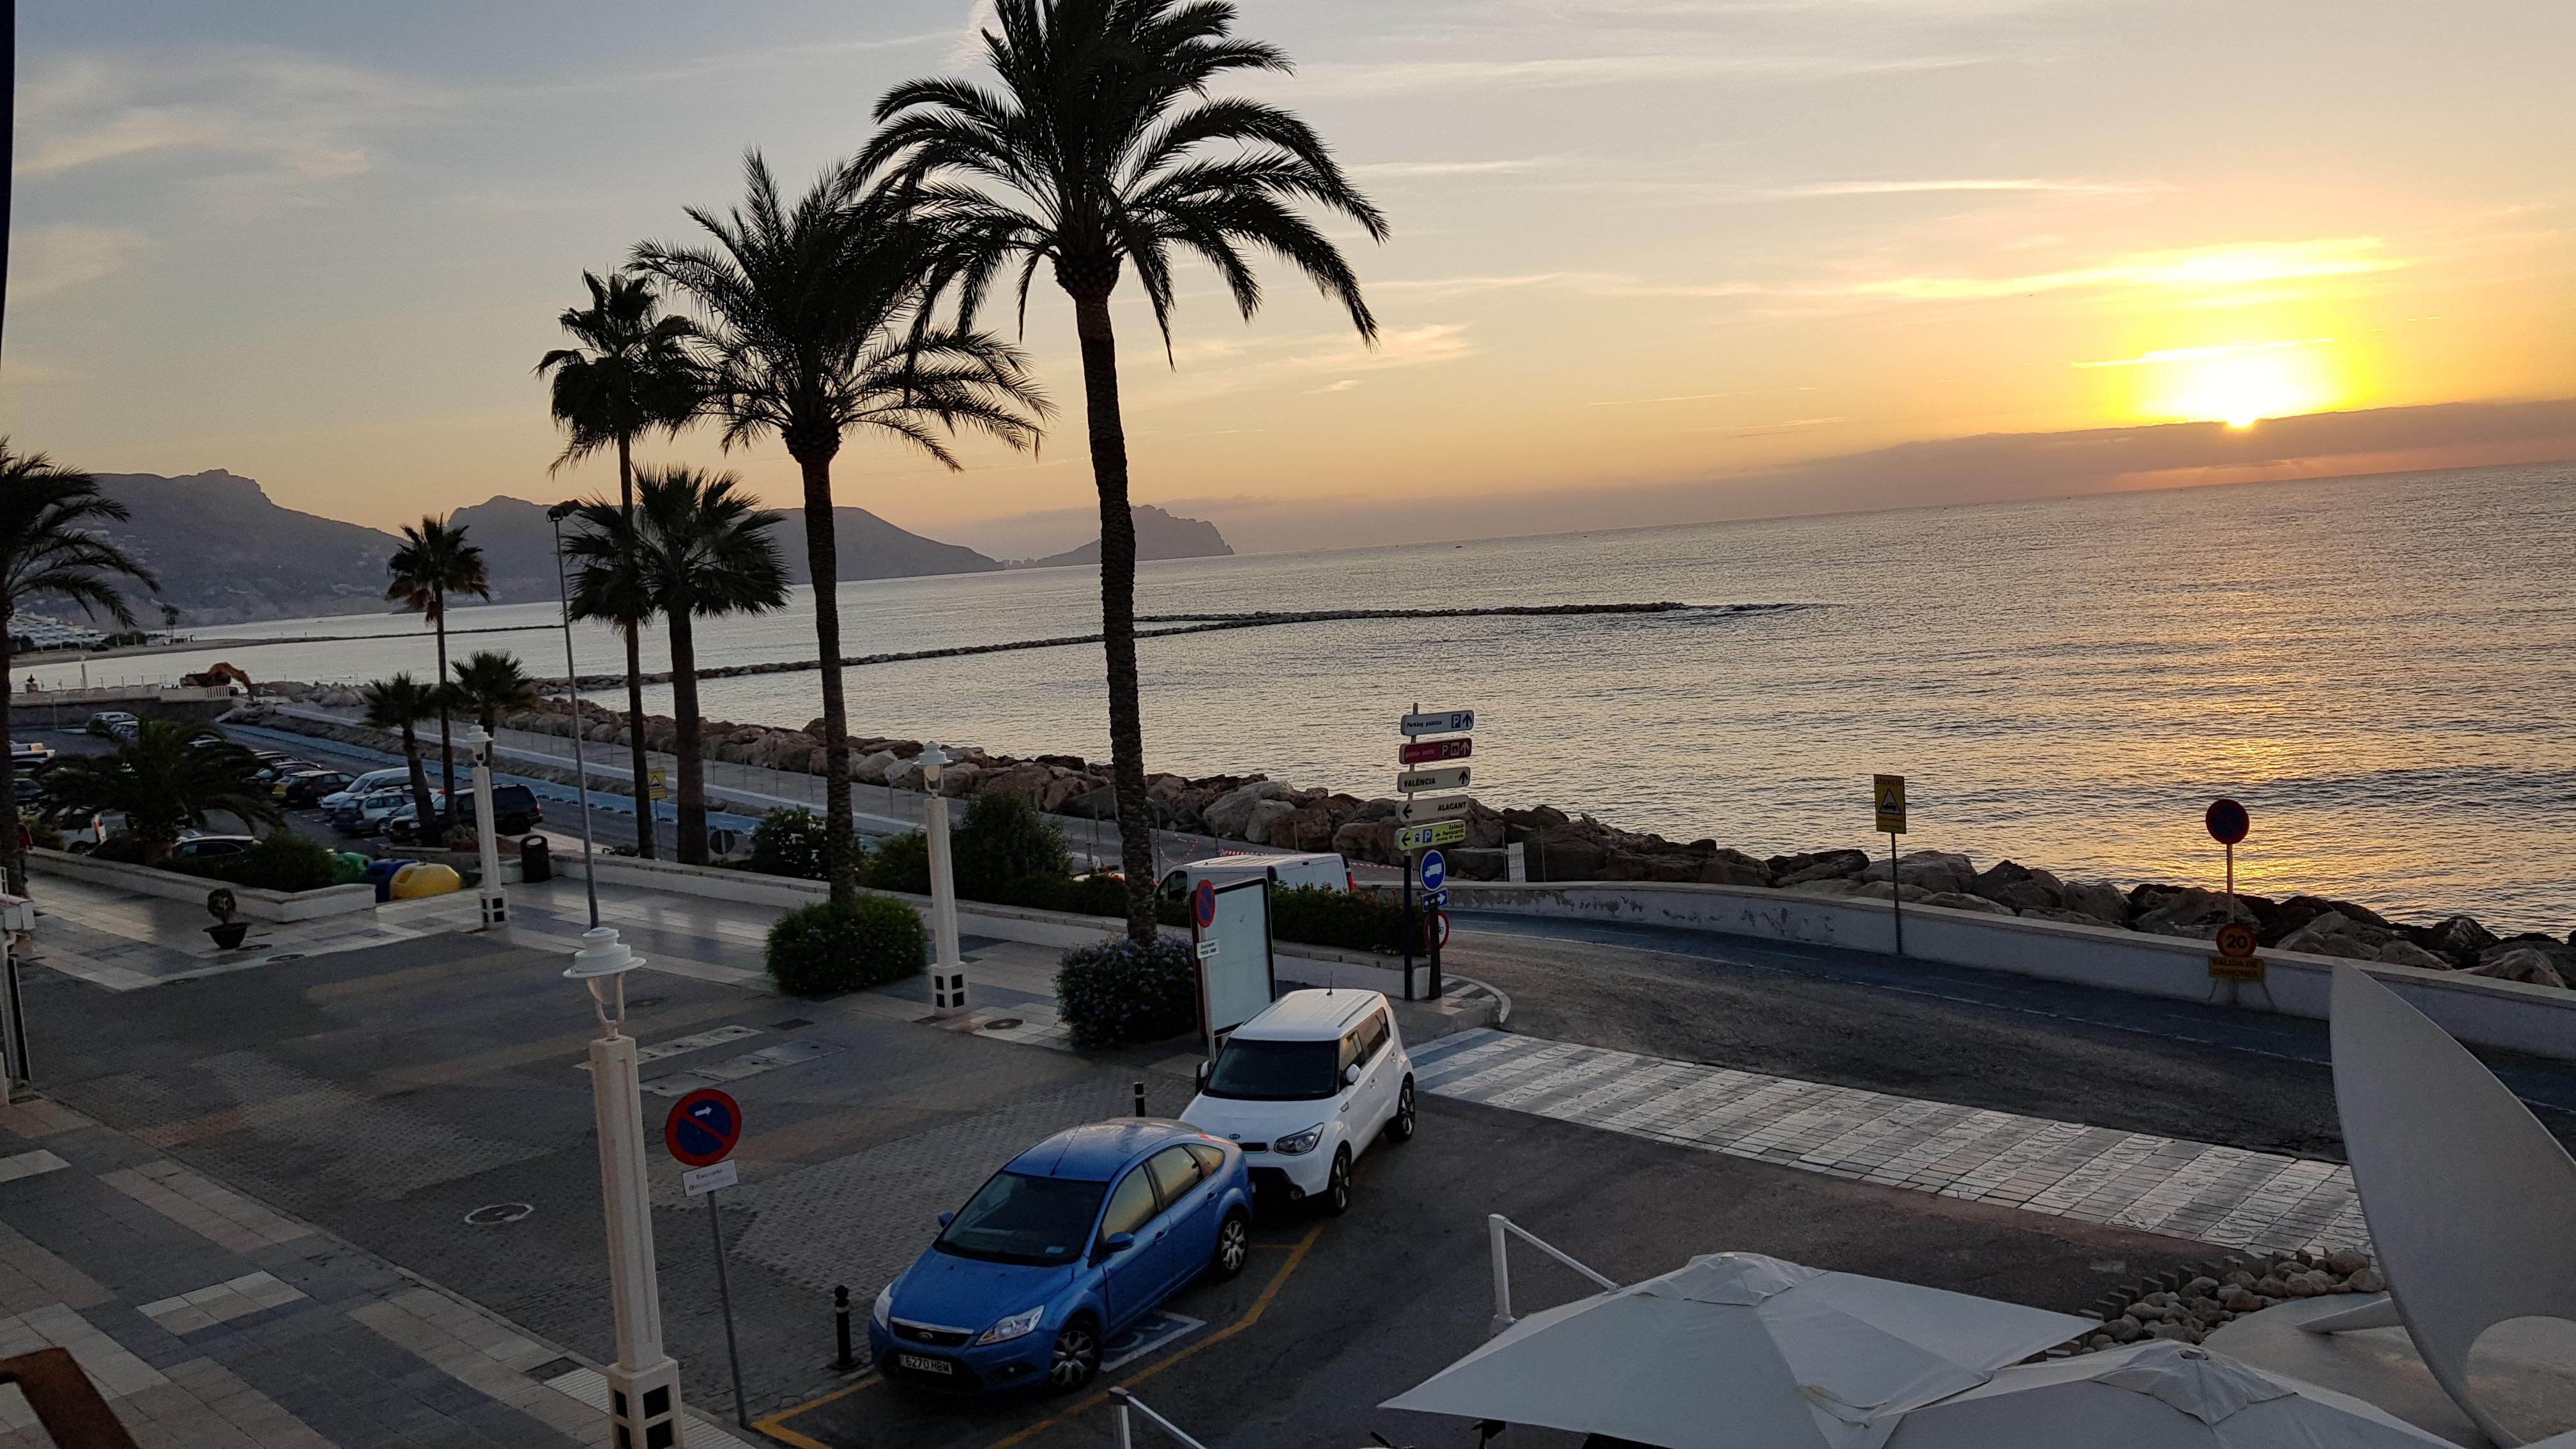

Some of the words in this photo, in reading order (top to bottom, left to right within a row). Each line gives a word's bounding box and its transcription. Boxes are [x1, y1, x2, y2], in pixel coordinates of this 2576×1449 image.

[1438, 801, 1467, 811] ALACANT
[2226, 933, 2248, 949] 20
[2246, 959, 2258, 967] DE
[2213, 969, 2259, 977] CAMIONES
[906, 1356, 930, 1369] 6270
